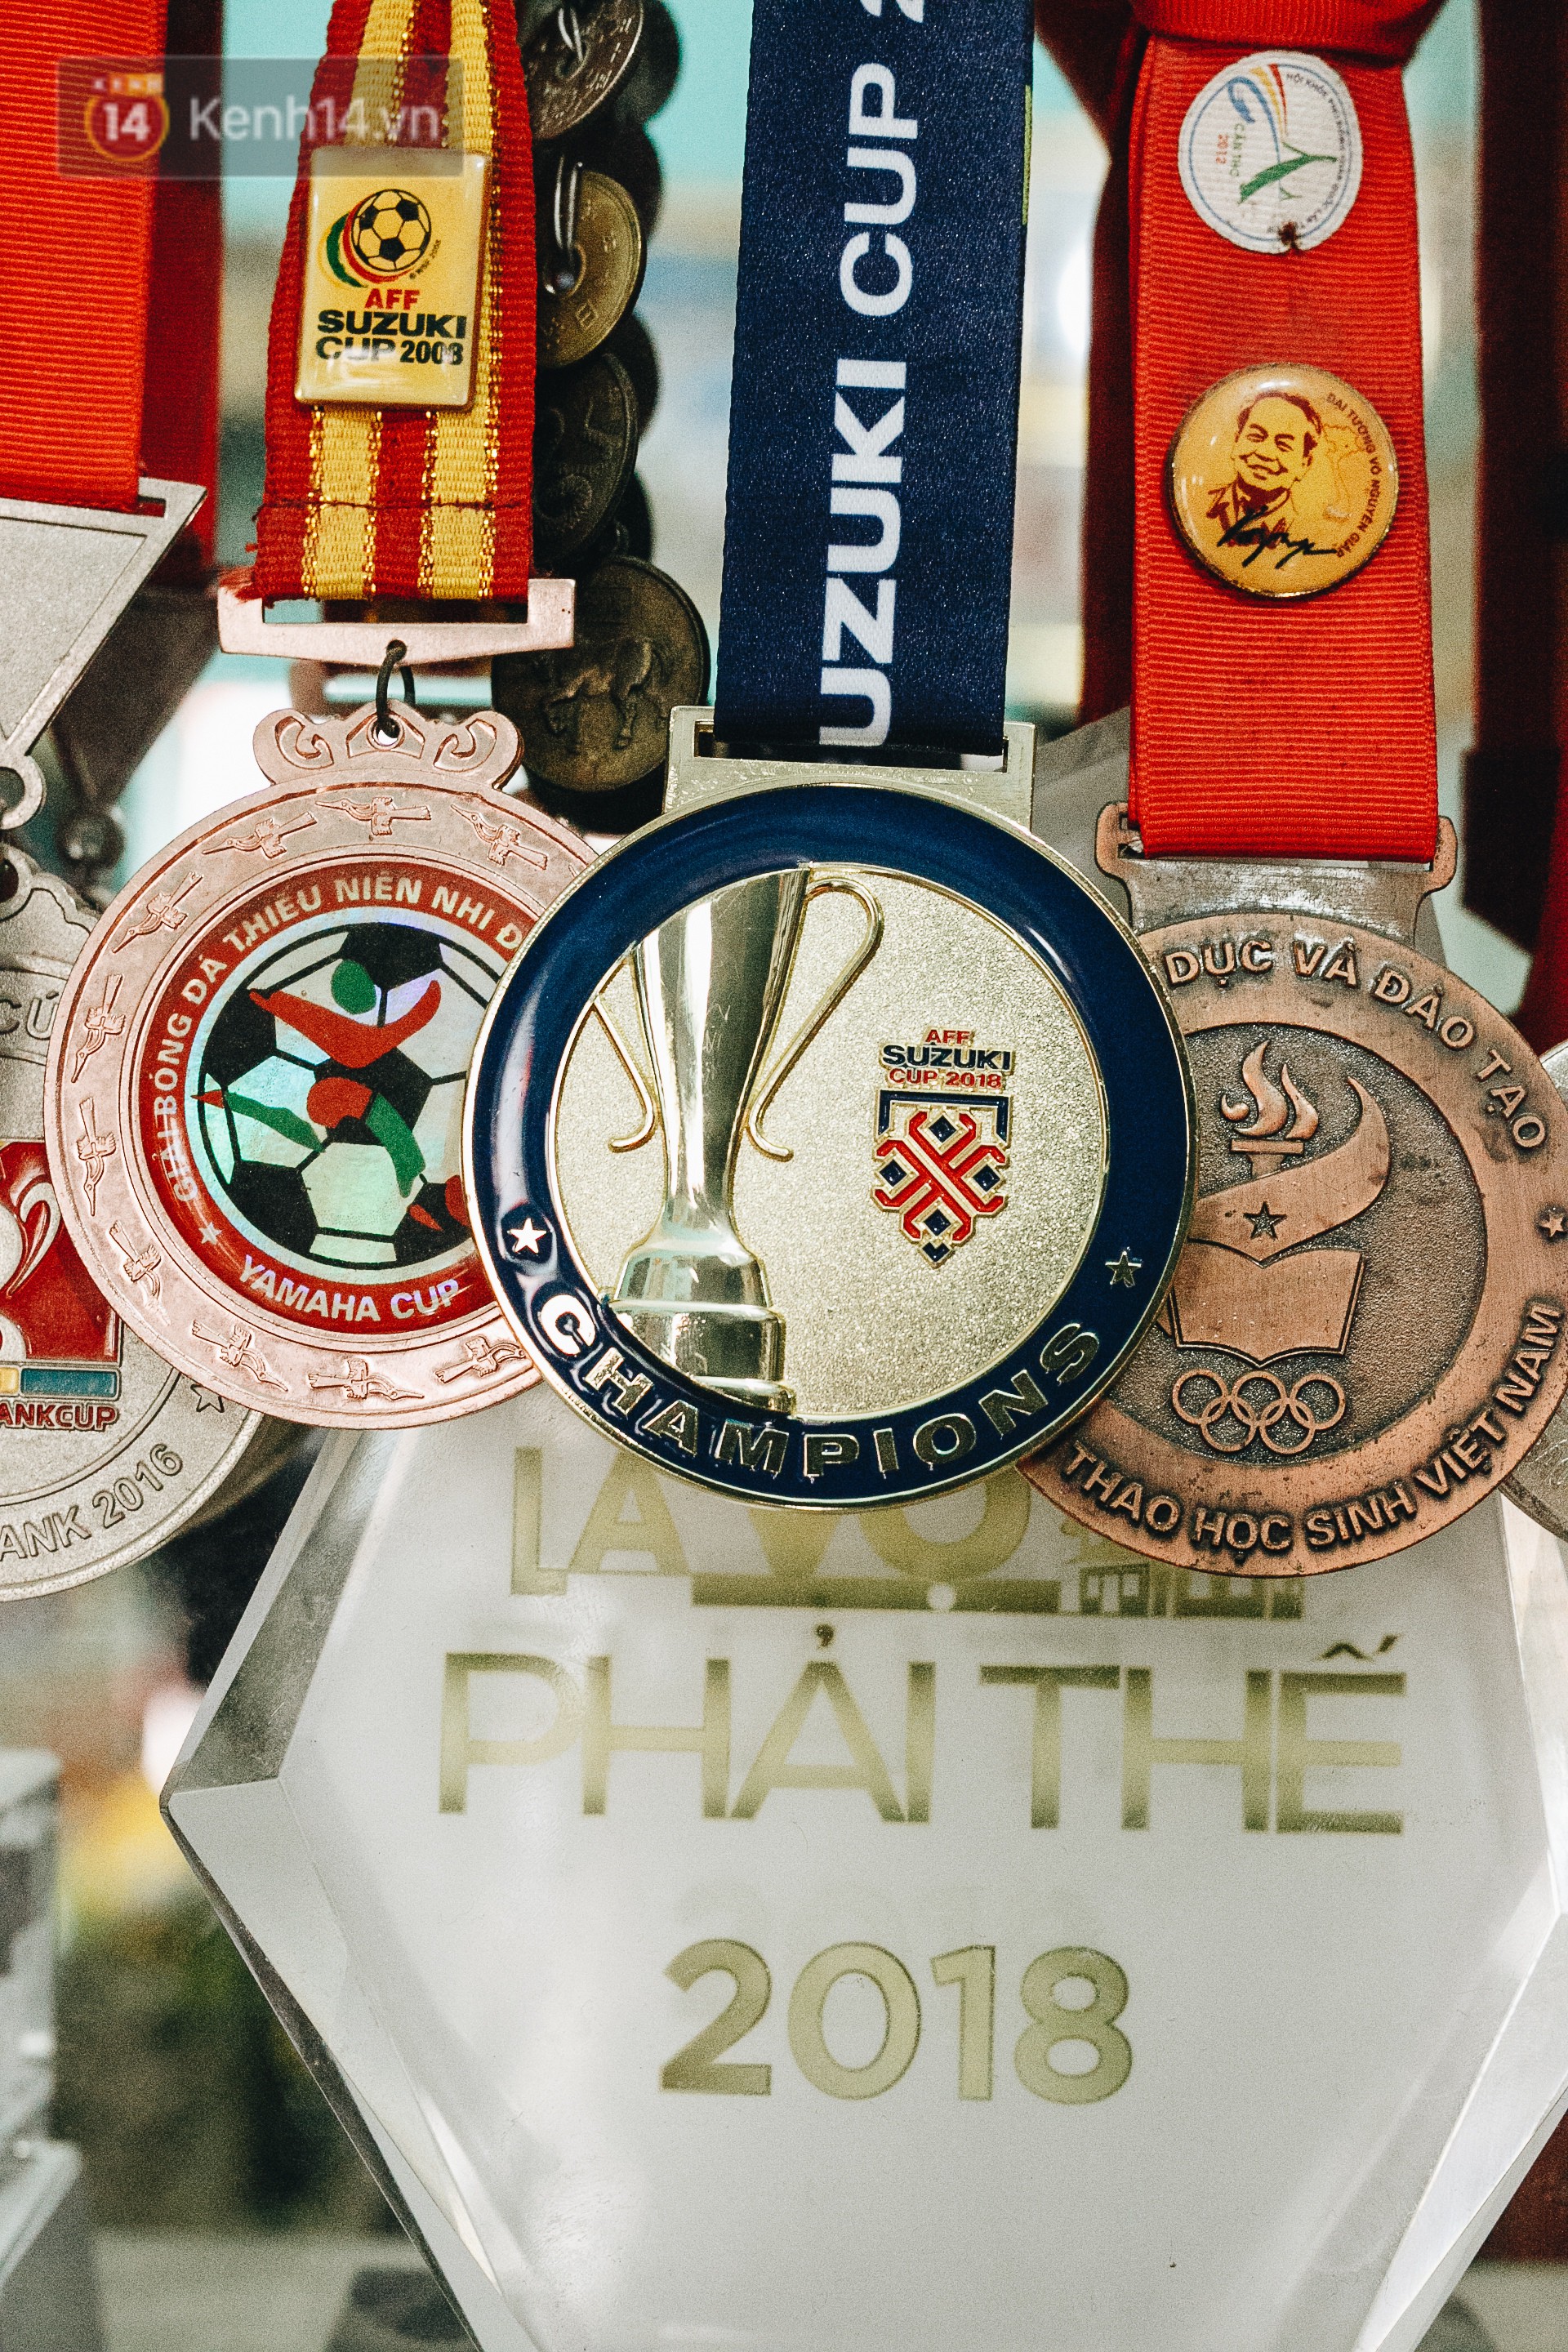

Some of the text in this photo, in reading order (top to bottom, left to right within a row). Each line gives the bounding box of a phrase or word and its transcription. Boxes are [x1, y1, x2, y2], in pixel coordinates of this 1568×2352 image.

[840, 62, 918, 318] CUP
[317, 310, 468, 340] SUZUKI
[364, 288, 421, 310] AFF
[315, 336, 397, 361] CUP
[149, 1013, 193, 1116] BÓNG
[431, 885, 496, 931] NHI
[924, 1028, 972, 1045] AFF
[1164, 939, 1273, 988] DỤC
[1292, 939, 1358, 988] VÀ
[1476, 1048, 1546, 1148] TẠO
[882, 1044, 1012, 1071] SUZUKI
[889, 1067, 1003, 1089] CUP 2018
[238, 1254, 460, 1323] YAMAHA CUP
[540, 1294, 1102, 1477] CHAMPIONS
[1063, 1440, 1180, 1533] THAO
[1193, 1508, 1294, 1566] HỌC
[1307, 1481, 1417, 1546] SINH
[1414, 1410, 1506, 1496] VIỆT
[1494, 1303, 1561, 1412] NAM
[91, 1443, 184, 1529] 2016
[439, 1624, 1408, 1833] PHẢI THẾ
[659, 1937, 1134, 2106] 2018
